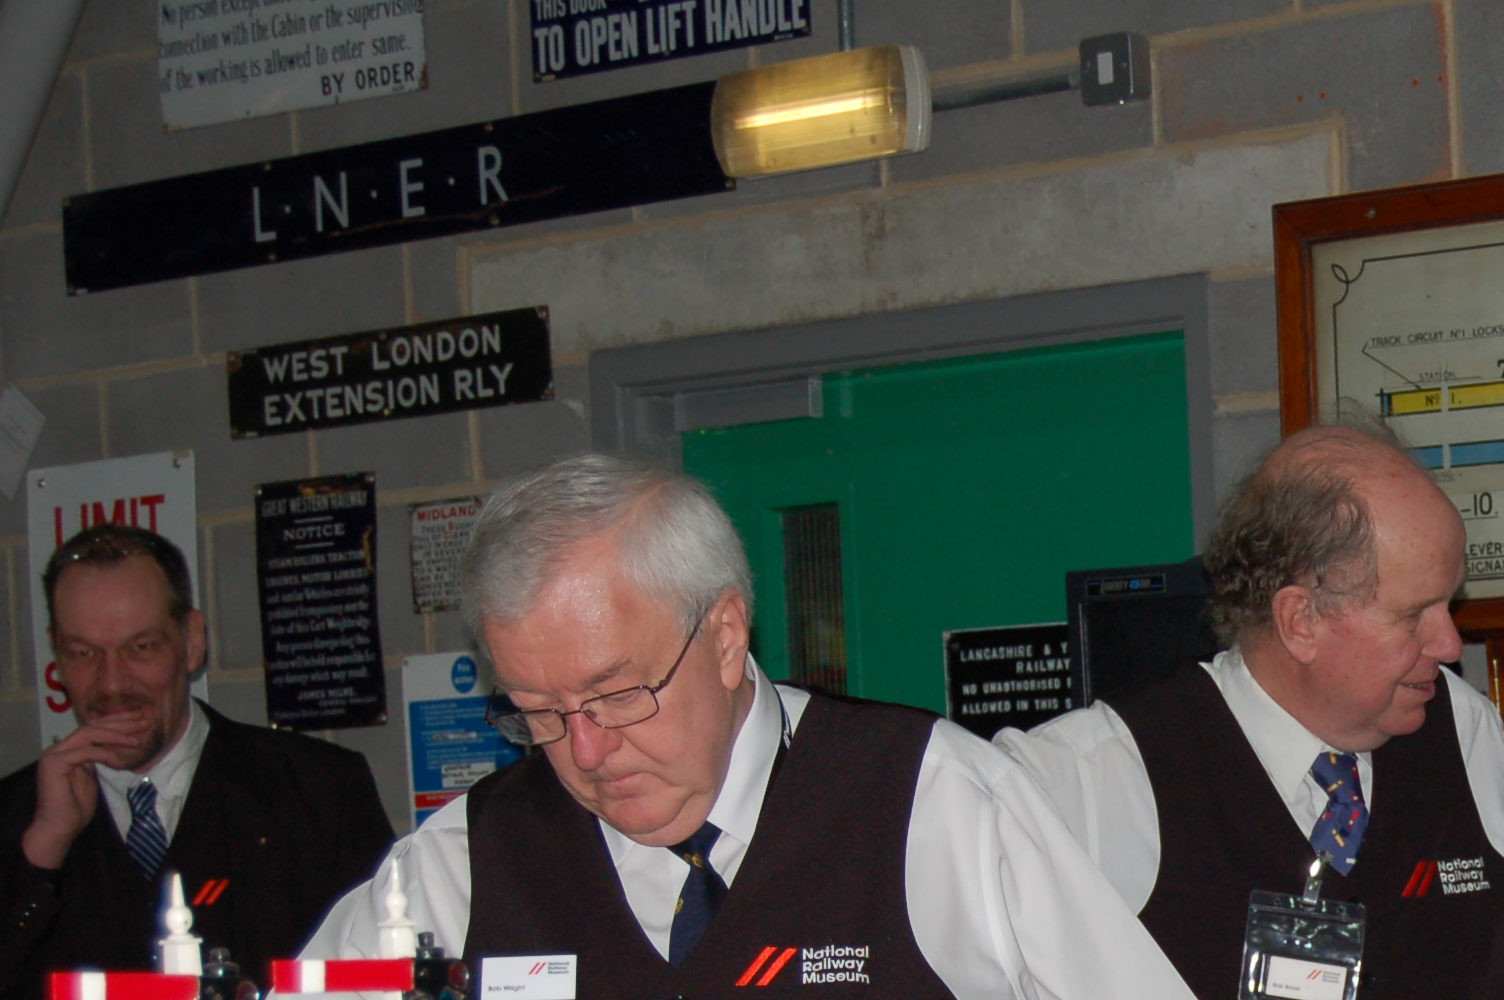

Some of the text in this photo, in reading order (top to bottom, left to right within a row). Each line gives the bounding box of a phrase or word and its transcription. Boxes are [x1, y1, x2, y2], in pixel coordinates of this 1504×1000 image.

[534, 0, 566, 21] THIS
[271, 11, 306, 39] Cabin
[325, 4, 343, 29] the
[534, 0, 807, 73] TO OPEN LIFT HANDLE
[264, 43, 311, 76] allowed
[316, 44, 328, 65] to
[331, 40, 365, 63] enter
[321, 61, 415, 96] BY ORDER
[1371, 336, 1401, 348] TRACK
[1407, 331, 1443, 343] CIRCUIT
[1472, 325, 1504, 338] LOCKS
[263, 324, 502, 385] WEST LONDON
[263, 362, 515, 427] EXTENSION RLY
[417, 504, 477, 521] MIDLAND
[282, 521, 346, 542] NOTICE
[960, 644, 1034, 662] LANCASHIRE
[1015, 658, 1072, 675] RAILWAY
[961, 682, 978, 696] NO
[982, 677, 1062, 695] UNAUTHORISED
[961, 700, 1012, 716] ALLOWED
[1034, 697, 1060, 711] THIS
[1437, 857, 1485, 873] National
[1439, 870, 1485, 884] Railway
[1442, 880, 1491, 895] Museum
[802, 945, 870, 960] National
[802, 959, 864, 974] Railway
[802, 971, 870, 985] Museum
